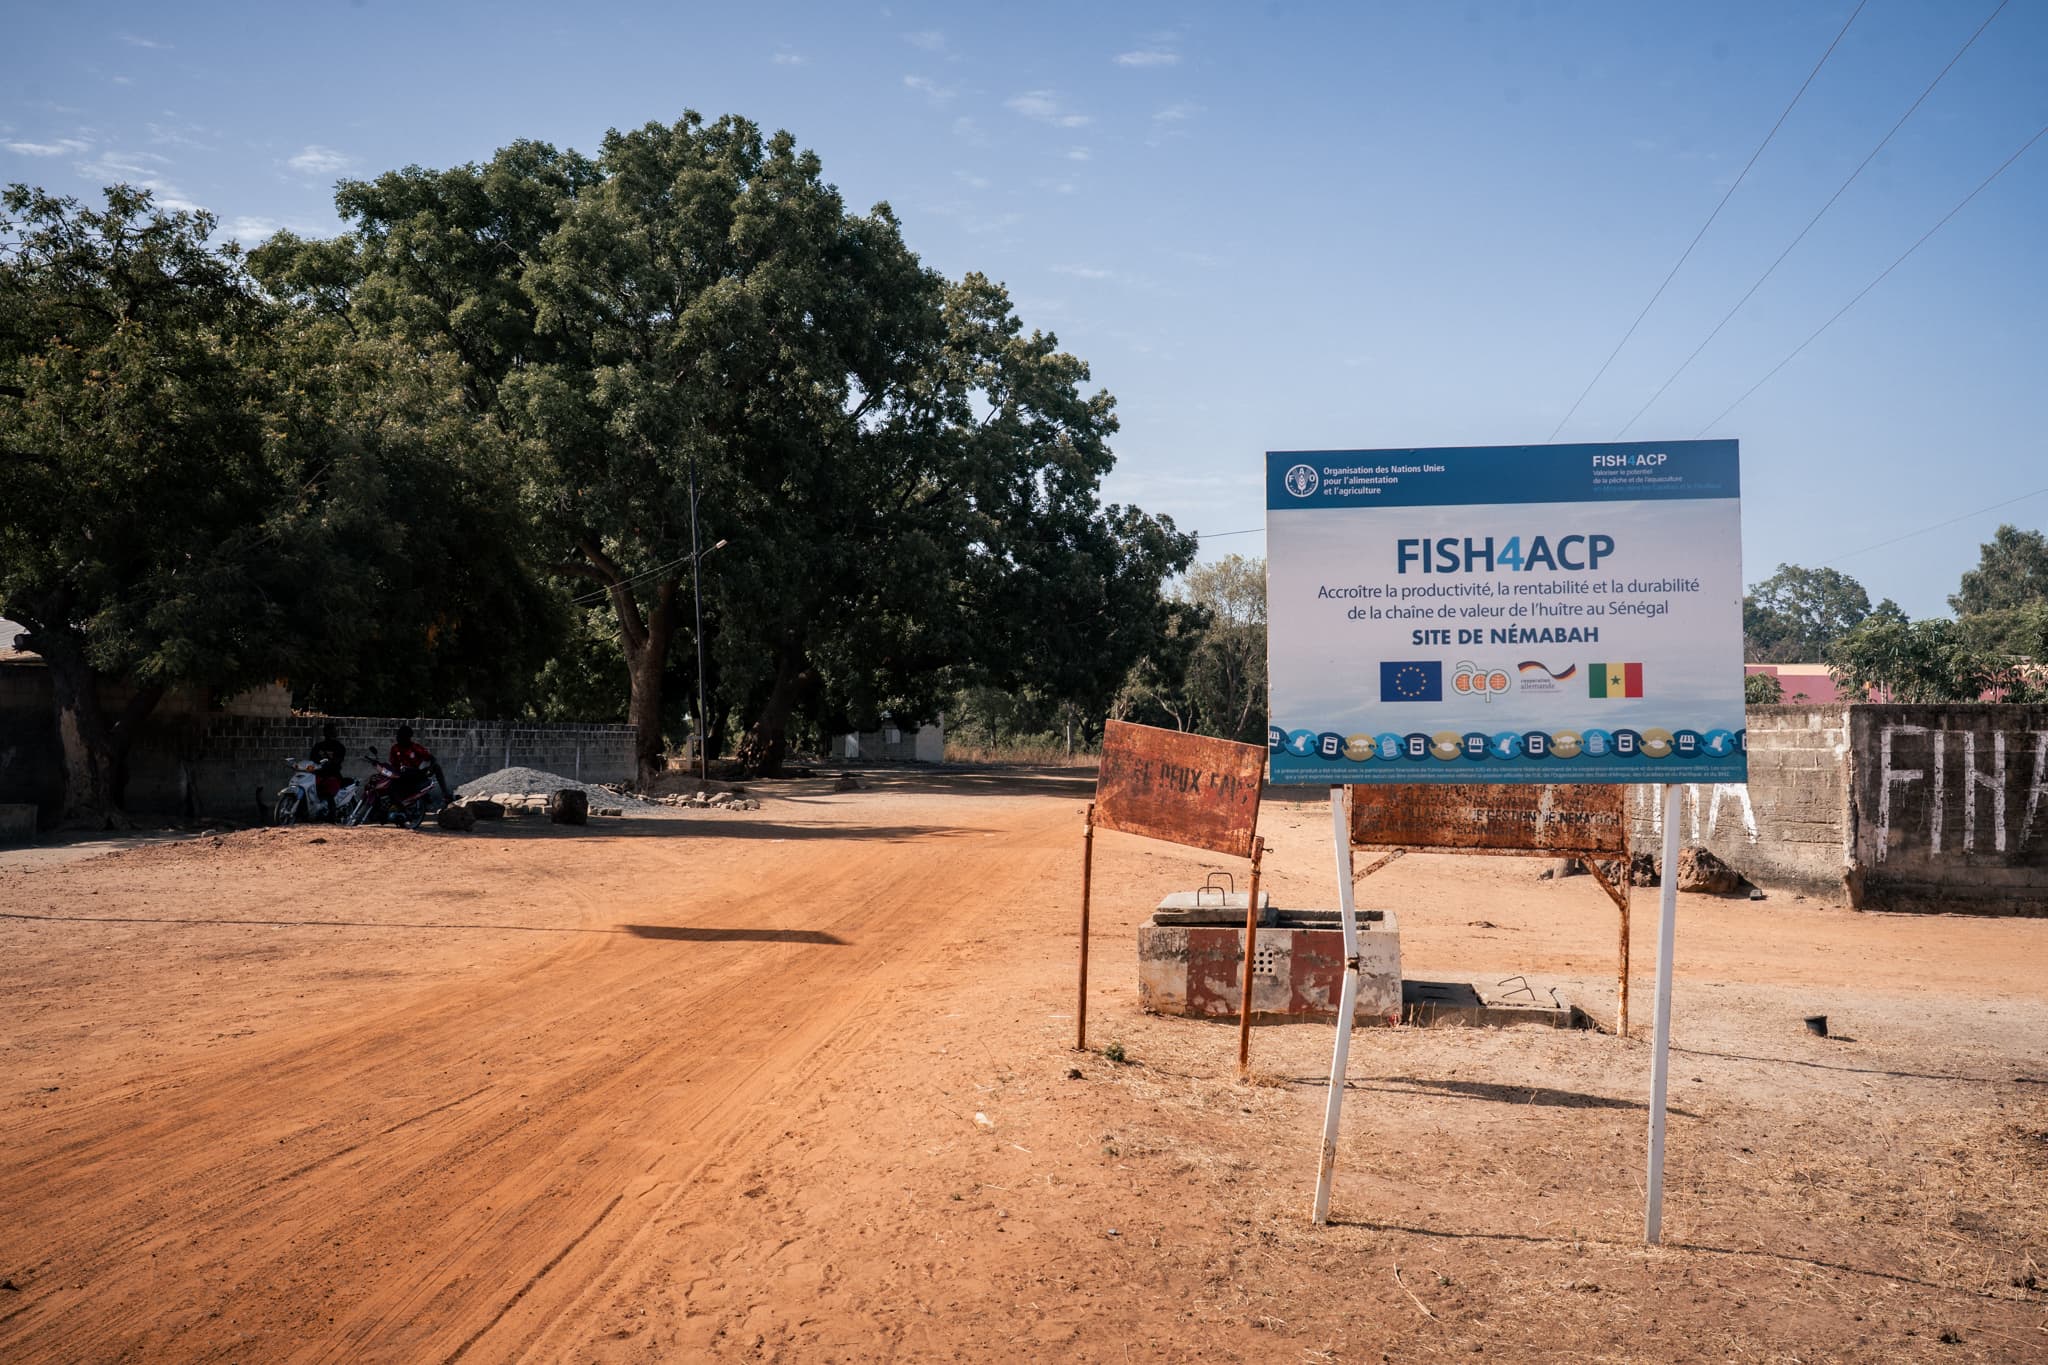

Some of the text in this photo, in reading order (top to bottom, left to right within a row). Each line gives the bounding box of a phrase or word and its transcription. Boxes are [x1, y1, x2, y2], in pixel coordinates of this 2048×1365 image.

[1592, 453, 1667, 467] FISH4ACP
[1323, 463, 1446, 476] Organisation des Nations Unies
[1323, 475, 1399, 487] pour l'alimentation
[1323, 488, 1332, 496] et
[1333, 486, 1382, 497] l'agriculture
[1397, 534, 1616, 574] FISH4ACP
[1317, 578, 1700, 600] Accroître la productivité, la rentabilité et la durabilité
[1347, 600, 1669, 620] de la chaîne de valeur de l'huître au Sénégal
[1412, 623, 1599, 646] SITE DE NÉMABAH
